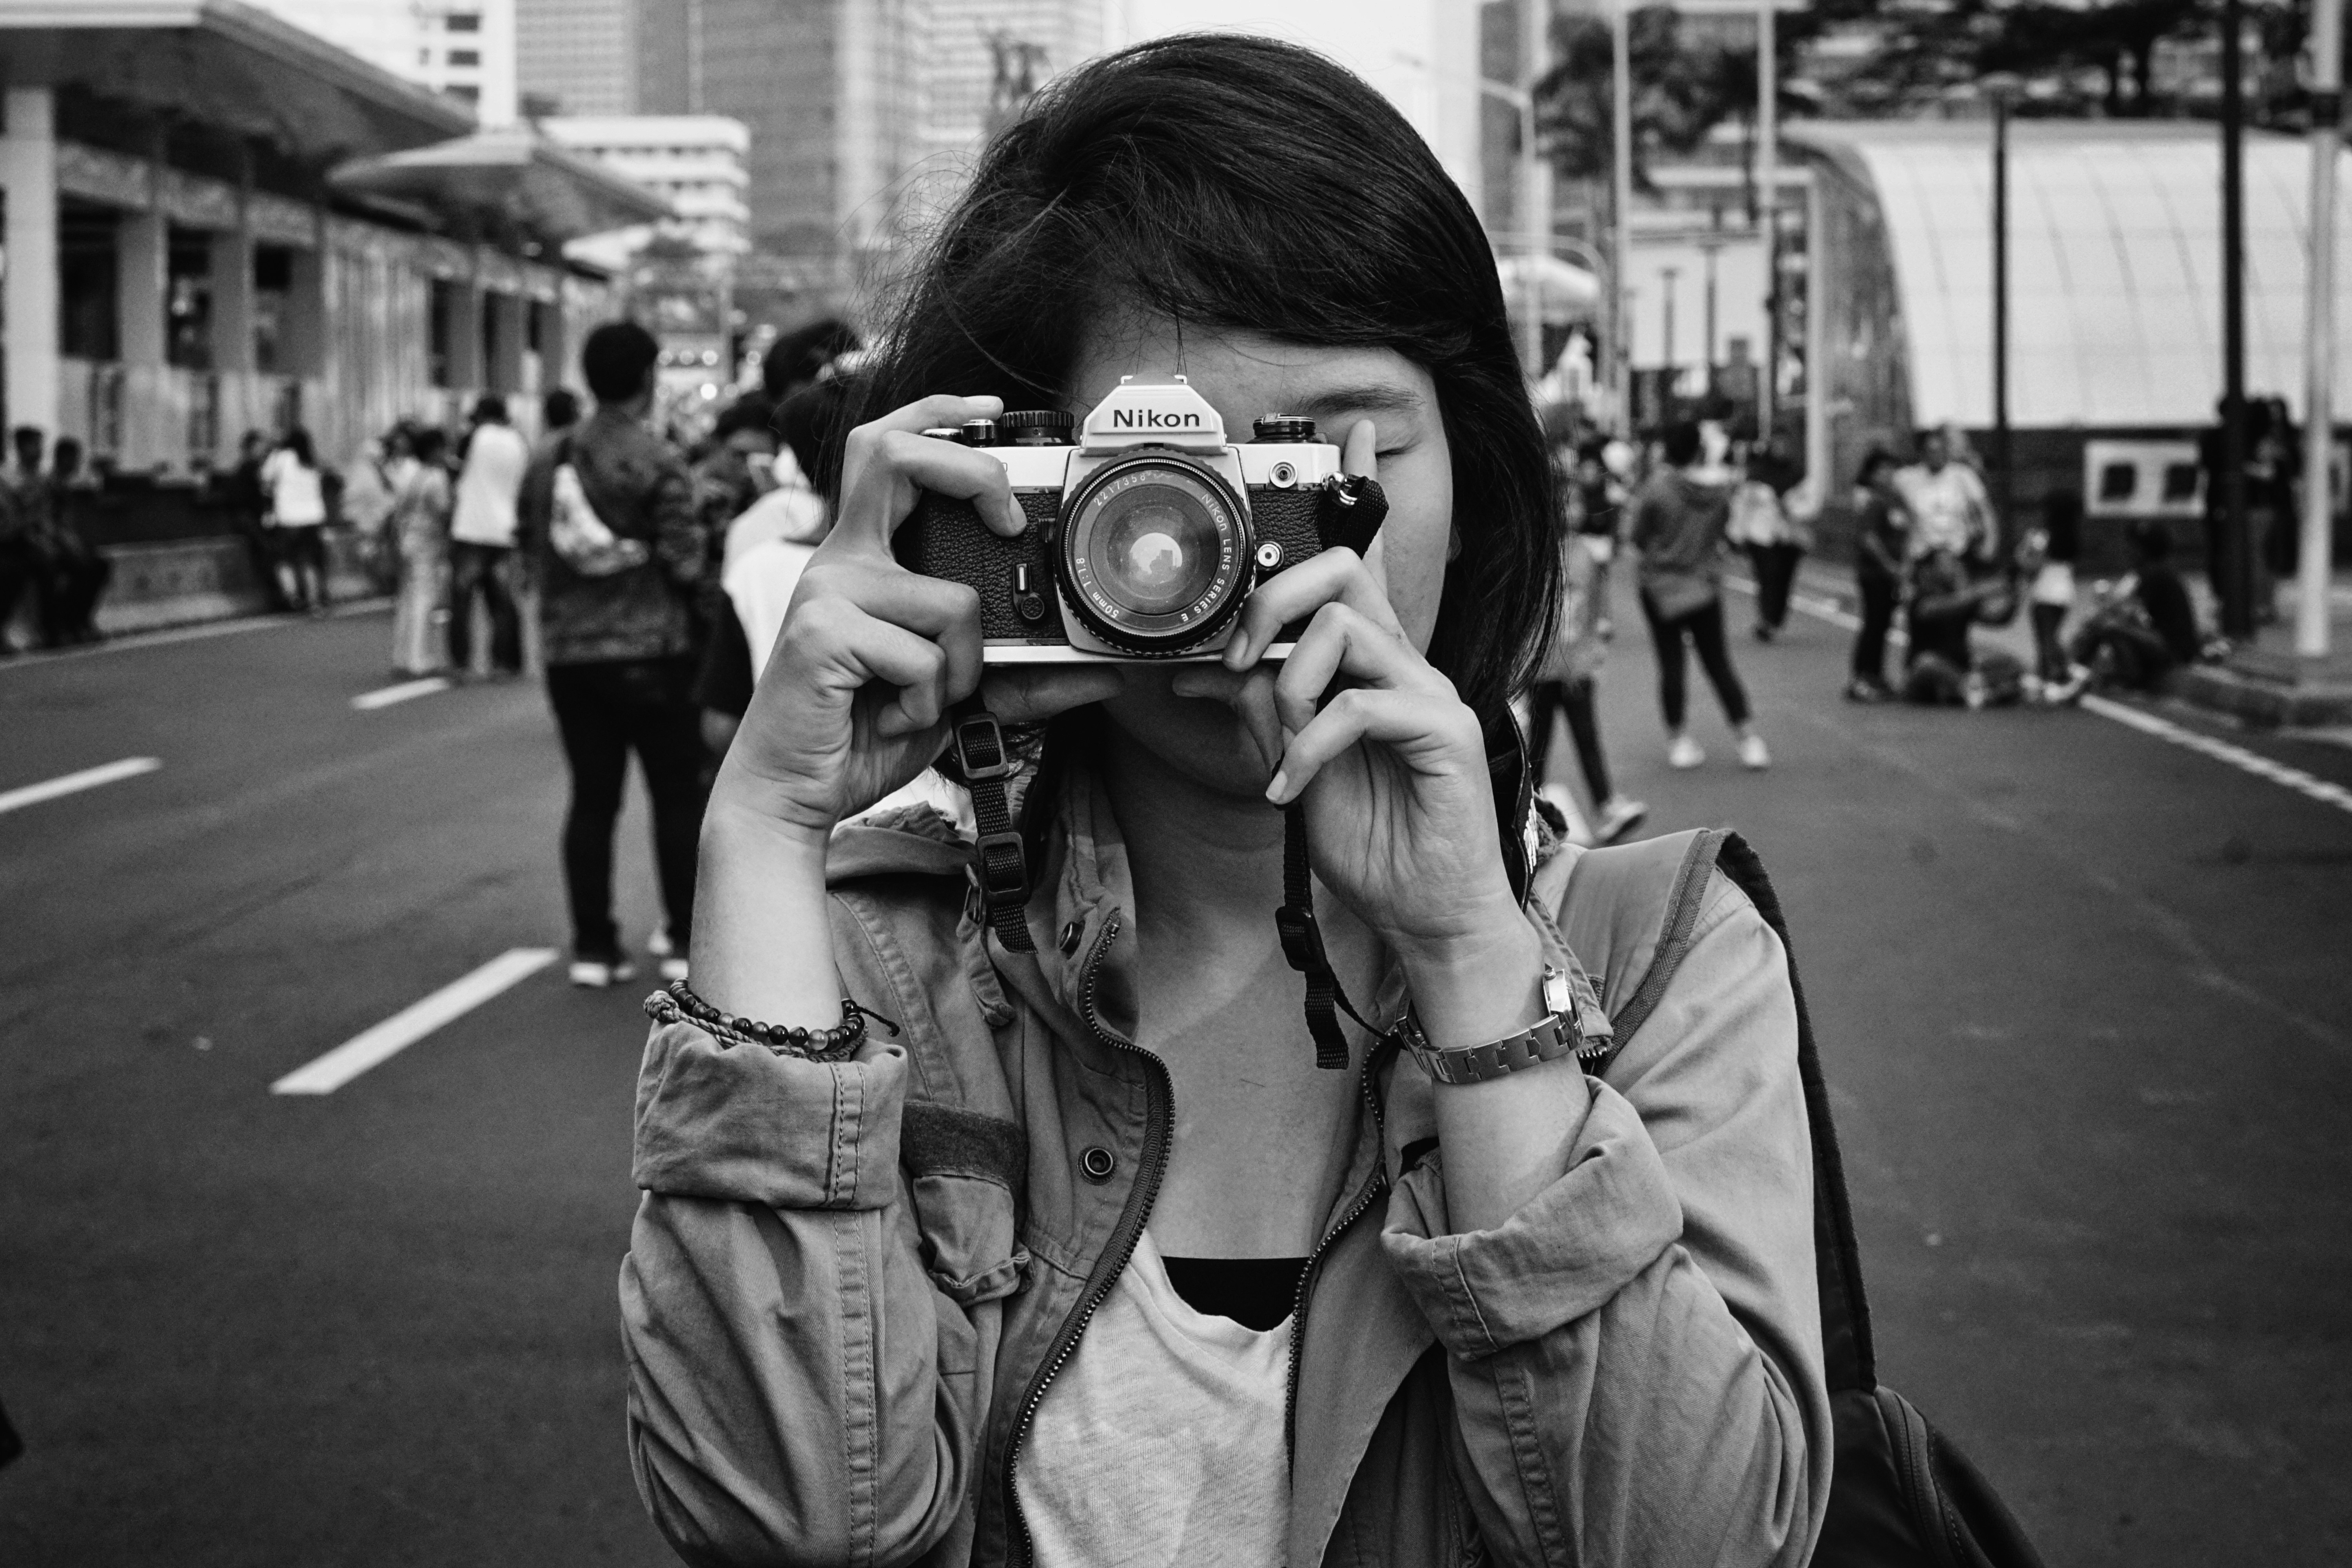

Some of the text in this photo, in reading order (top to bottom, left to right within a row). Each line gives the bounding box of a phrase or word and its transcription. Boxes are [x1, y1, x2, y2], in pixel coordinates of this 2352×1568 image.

[1114, 409, 1200, 427] Nikon
[1094, 473, 1145, 506] 2217358
[1076, 494, 1232, 622] Nikon LENS SERIES E 50mm 1:1.8
